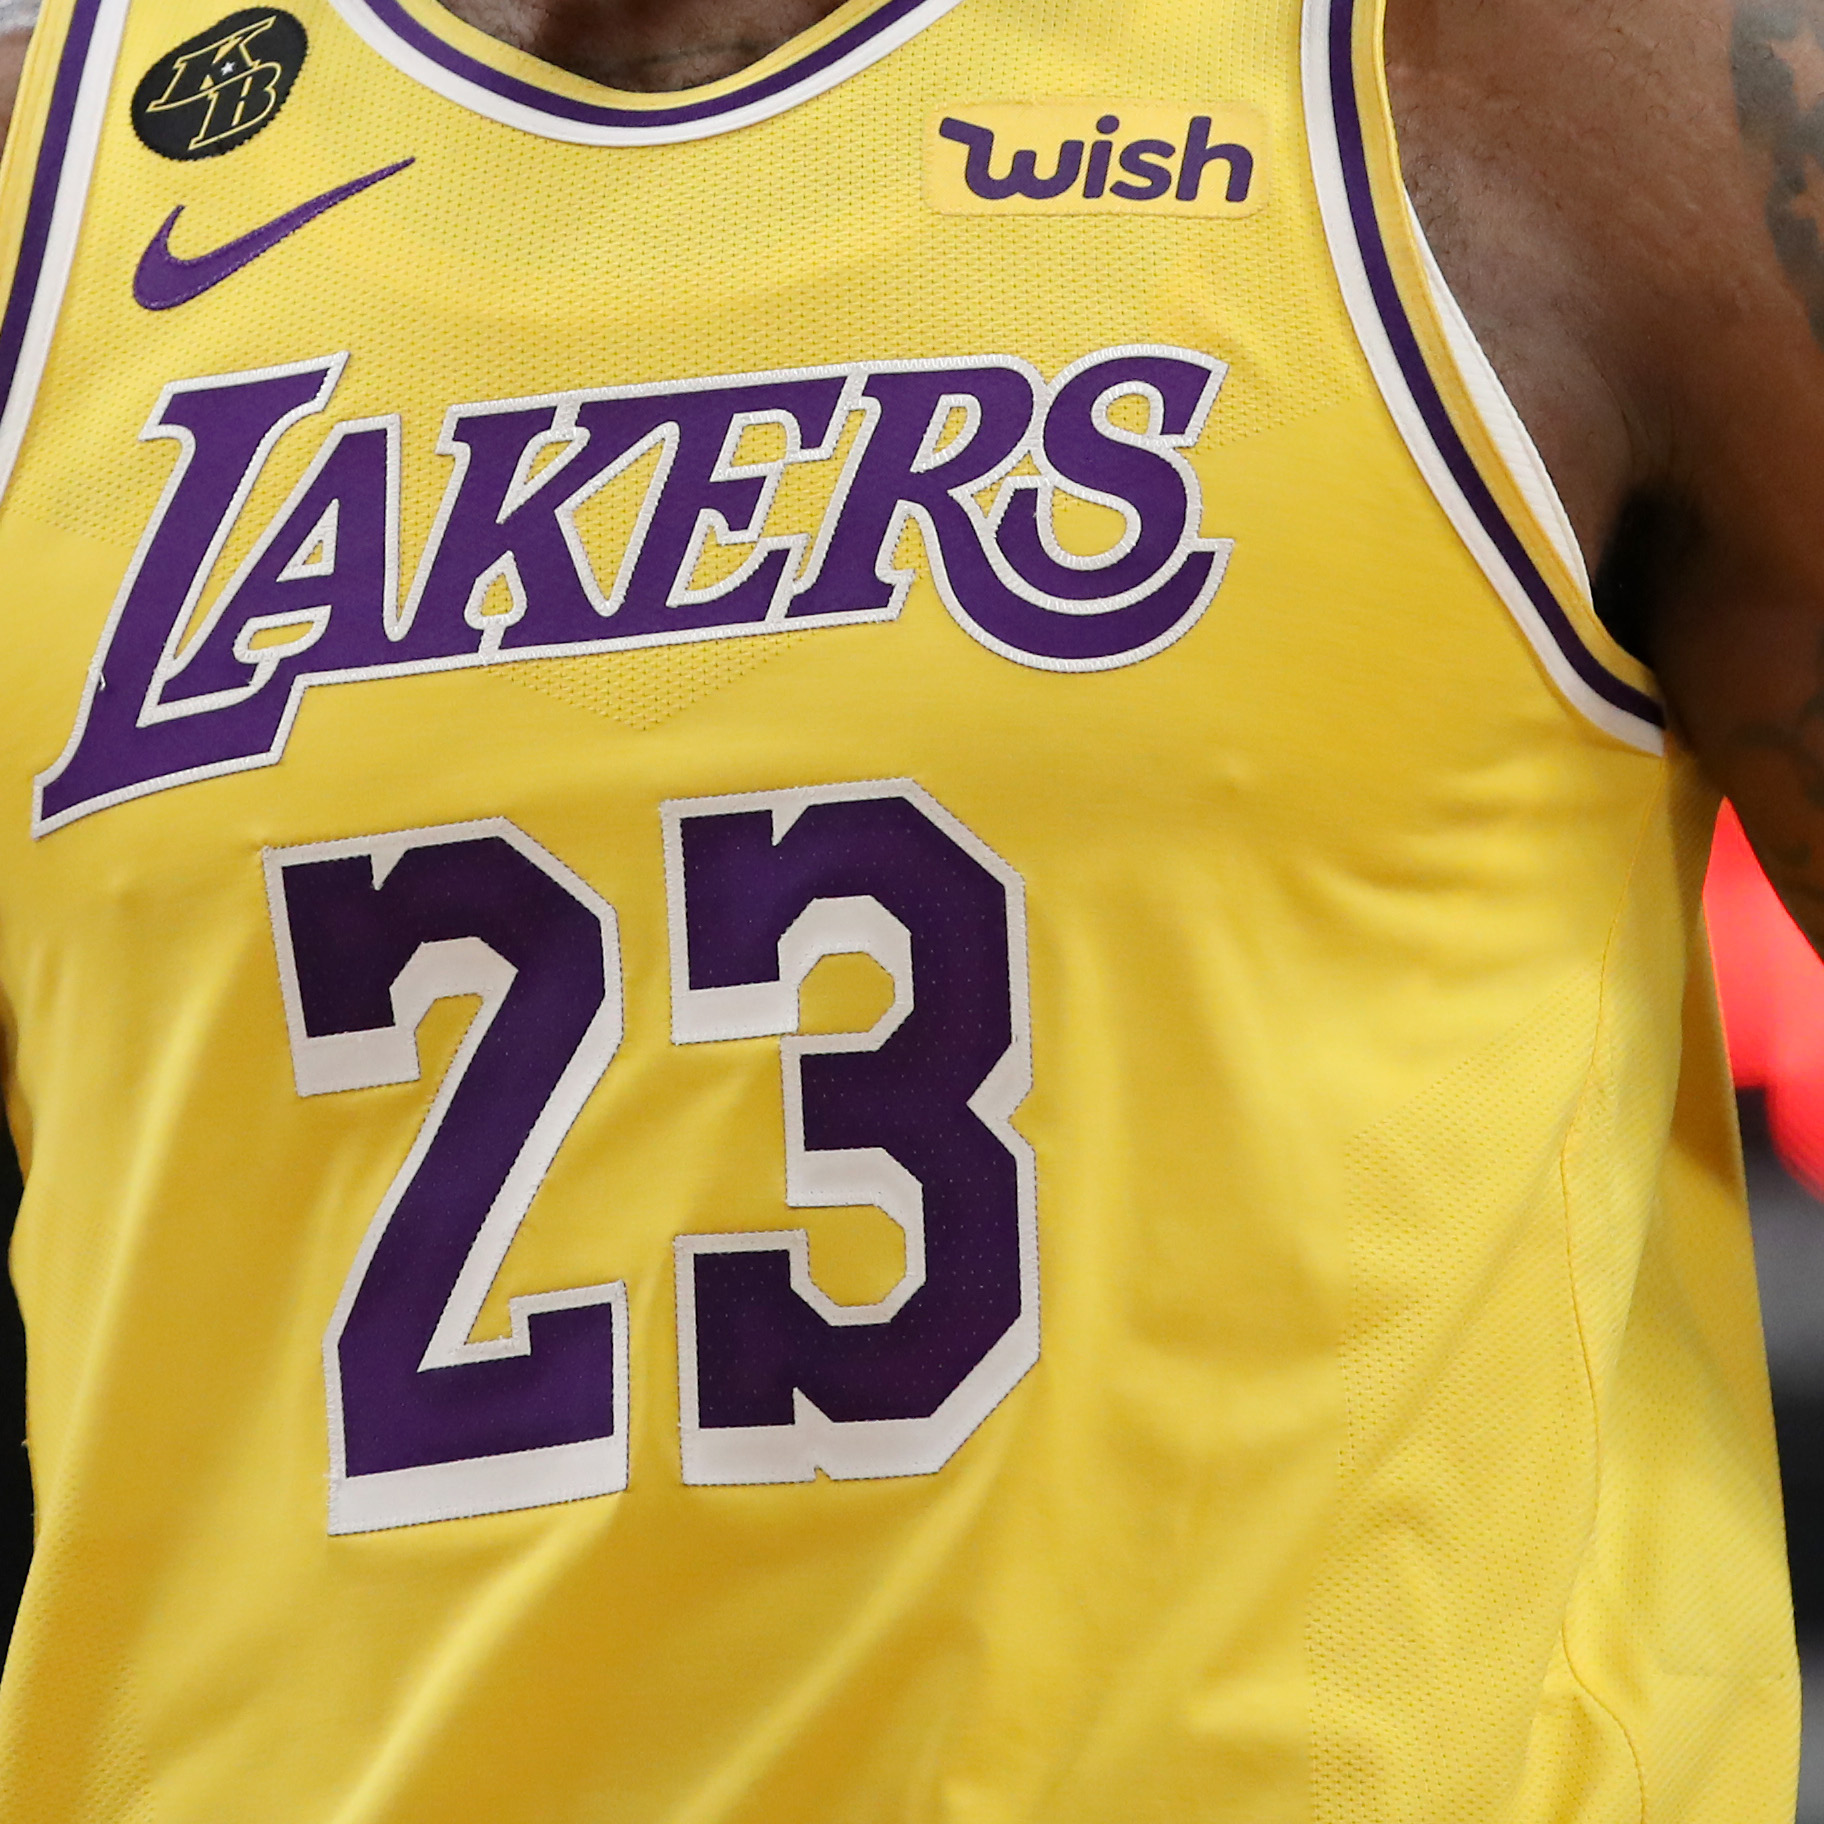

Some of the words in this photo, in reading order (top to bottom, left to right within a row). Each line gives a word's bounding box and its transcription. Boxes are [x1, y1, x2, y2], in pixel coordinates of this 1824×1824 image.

[938, 114, 1254, 203] wish
[33, 344, 1234, 839] LAKERS
[262, 777, 1041, 1537] 23
